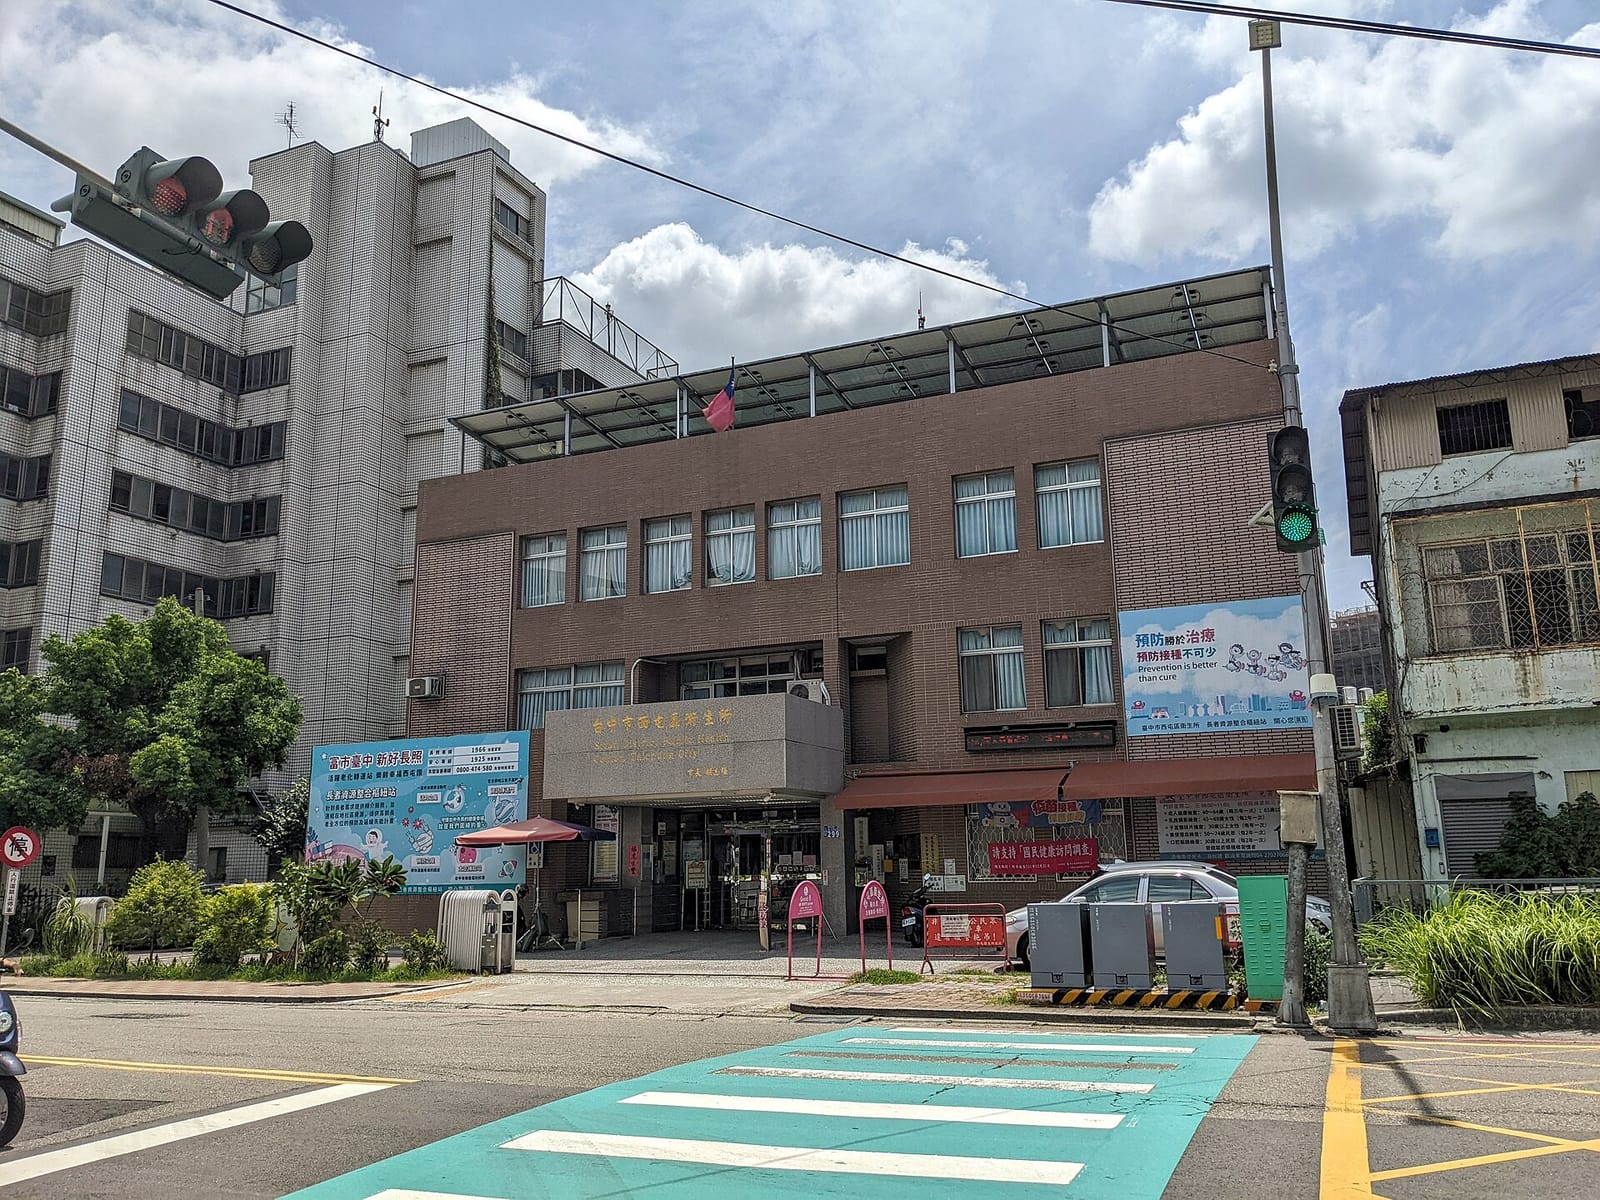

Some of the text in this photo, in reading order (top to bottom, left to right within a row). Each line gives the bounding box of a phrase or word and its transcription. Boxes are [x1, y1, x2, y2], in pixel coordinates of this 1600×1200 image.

[1135, 628, 1216, 648] 預防勝於治療
[1136, 646, 1217, 663] 預防接種不可少
[1138, 661, 1218, 673] Prevention is better
[1138, 673, 1177, 683] than cure
[329, 749, 424, 770] 富市臺中 新好長照
[827, 830, 840, 838] 299
[9, 836, 28, 857] 停
[992, 842, 1093, 860] 請支持「國民健康訪問調查」
